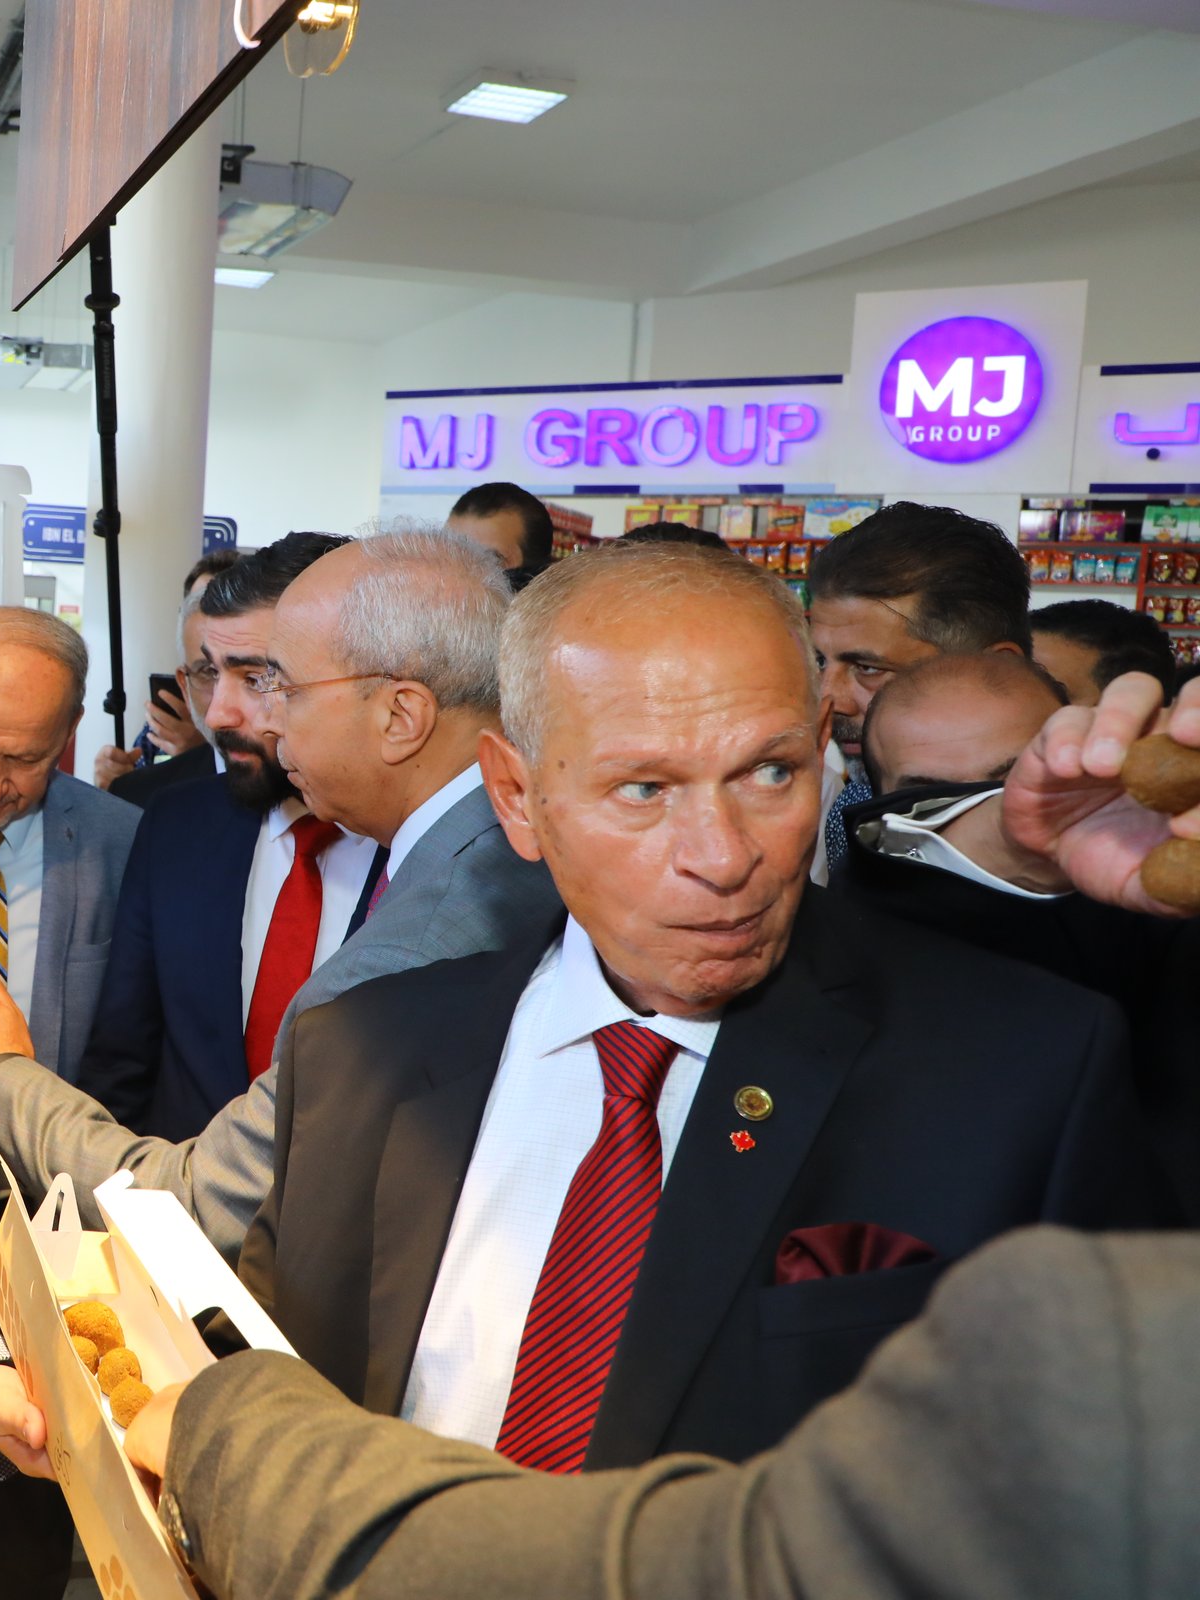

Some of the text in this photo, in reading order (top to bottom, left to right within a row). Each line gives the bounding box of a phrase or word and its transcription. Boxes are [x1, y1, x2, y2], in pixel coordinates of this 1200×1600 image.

[895, 355, 1027, 418] MJ
[400, 403, 819, 470] MJ GROUP
[910, 425, 1002, 443] GROUP
